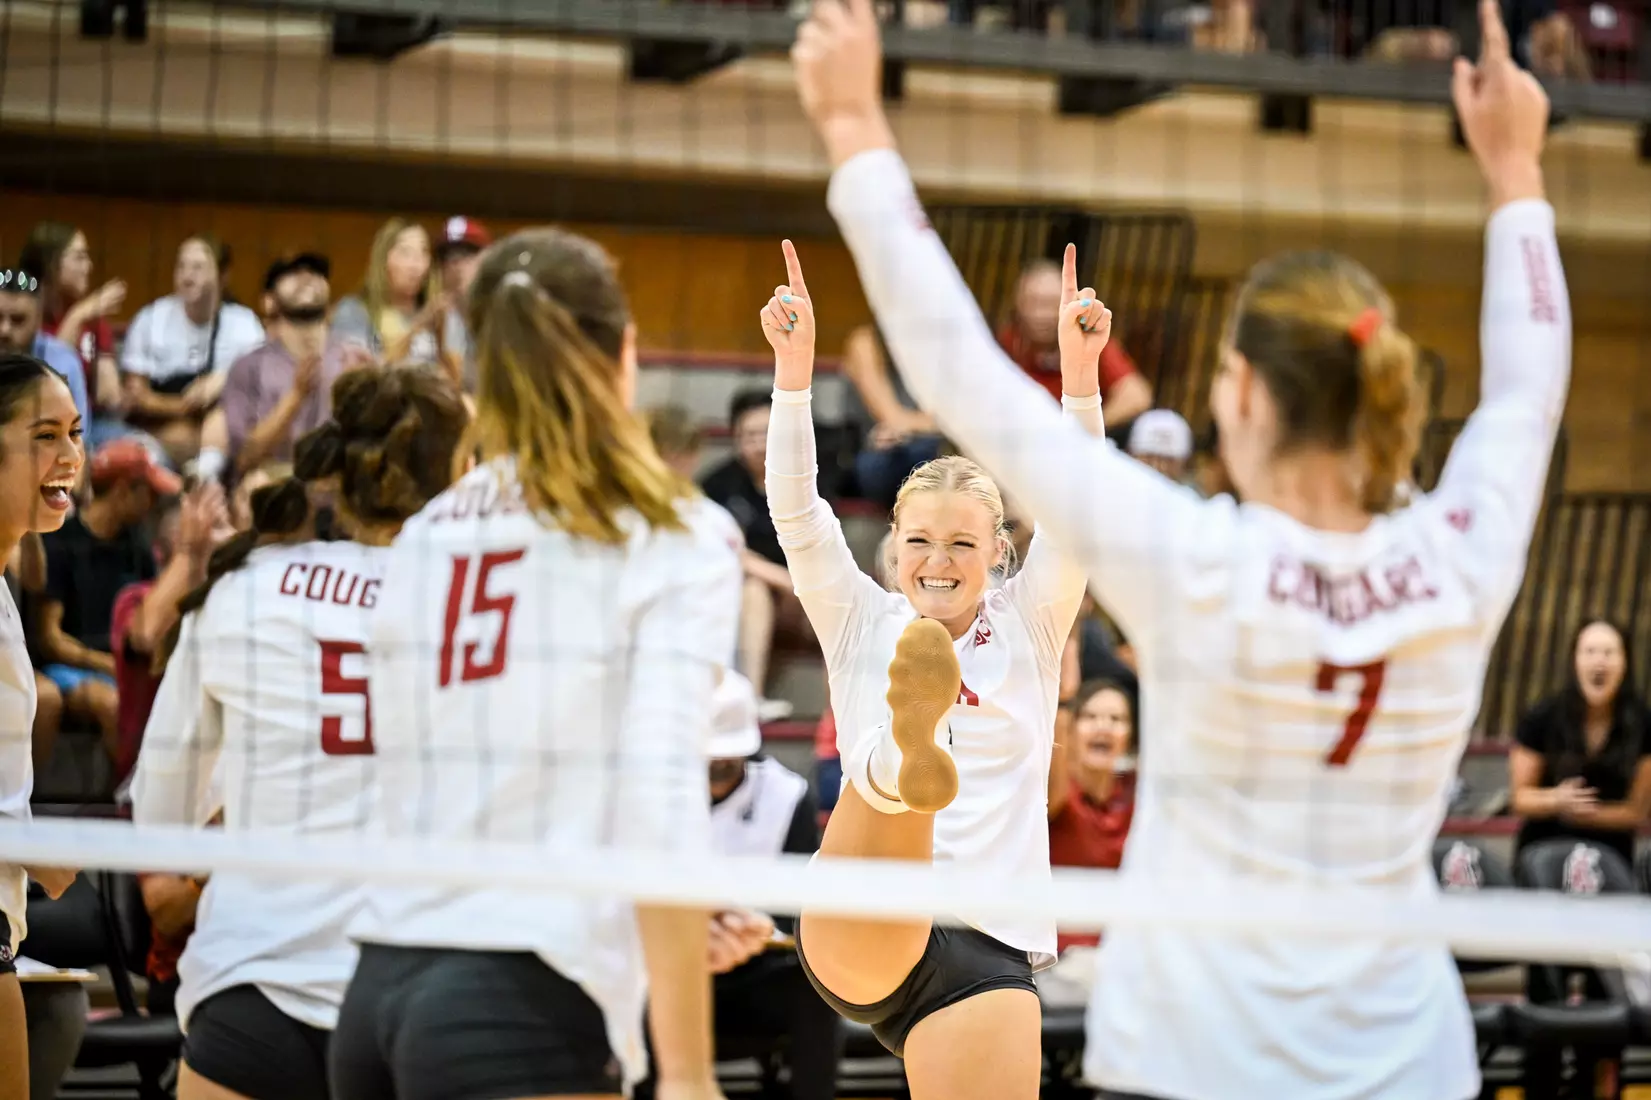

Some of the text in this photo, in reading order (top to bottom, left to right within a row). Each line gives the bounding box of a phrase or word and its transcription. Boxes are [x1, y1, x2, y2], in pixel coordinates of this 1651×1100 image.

[439, 547, 527, 688] 15
[317, 640, 376, 755] 5
[1316, 657, 1386, 766] 7
